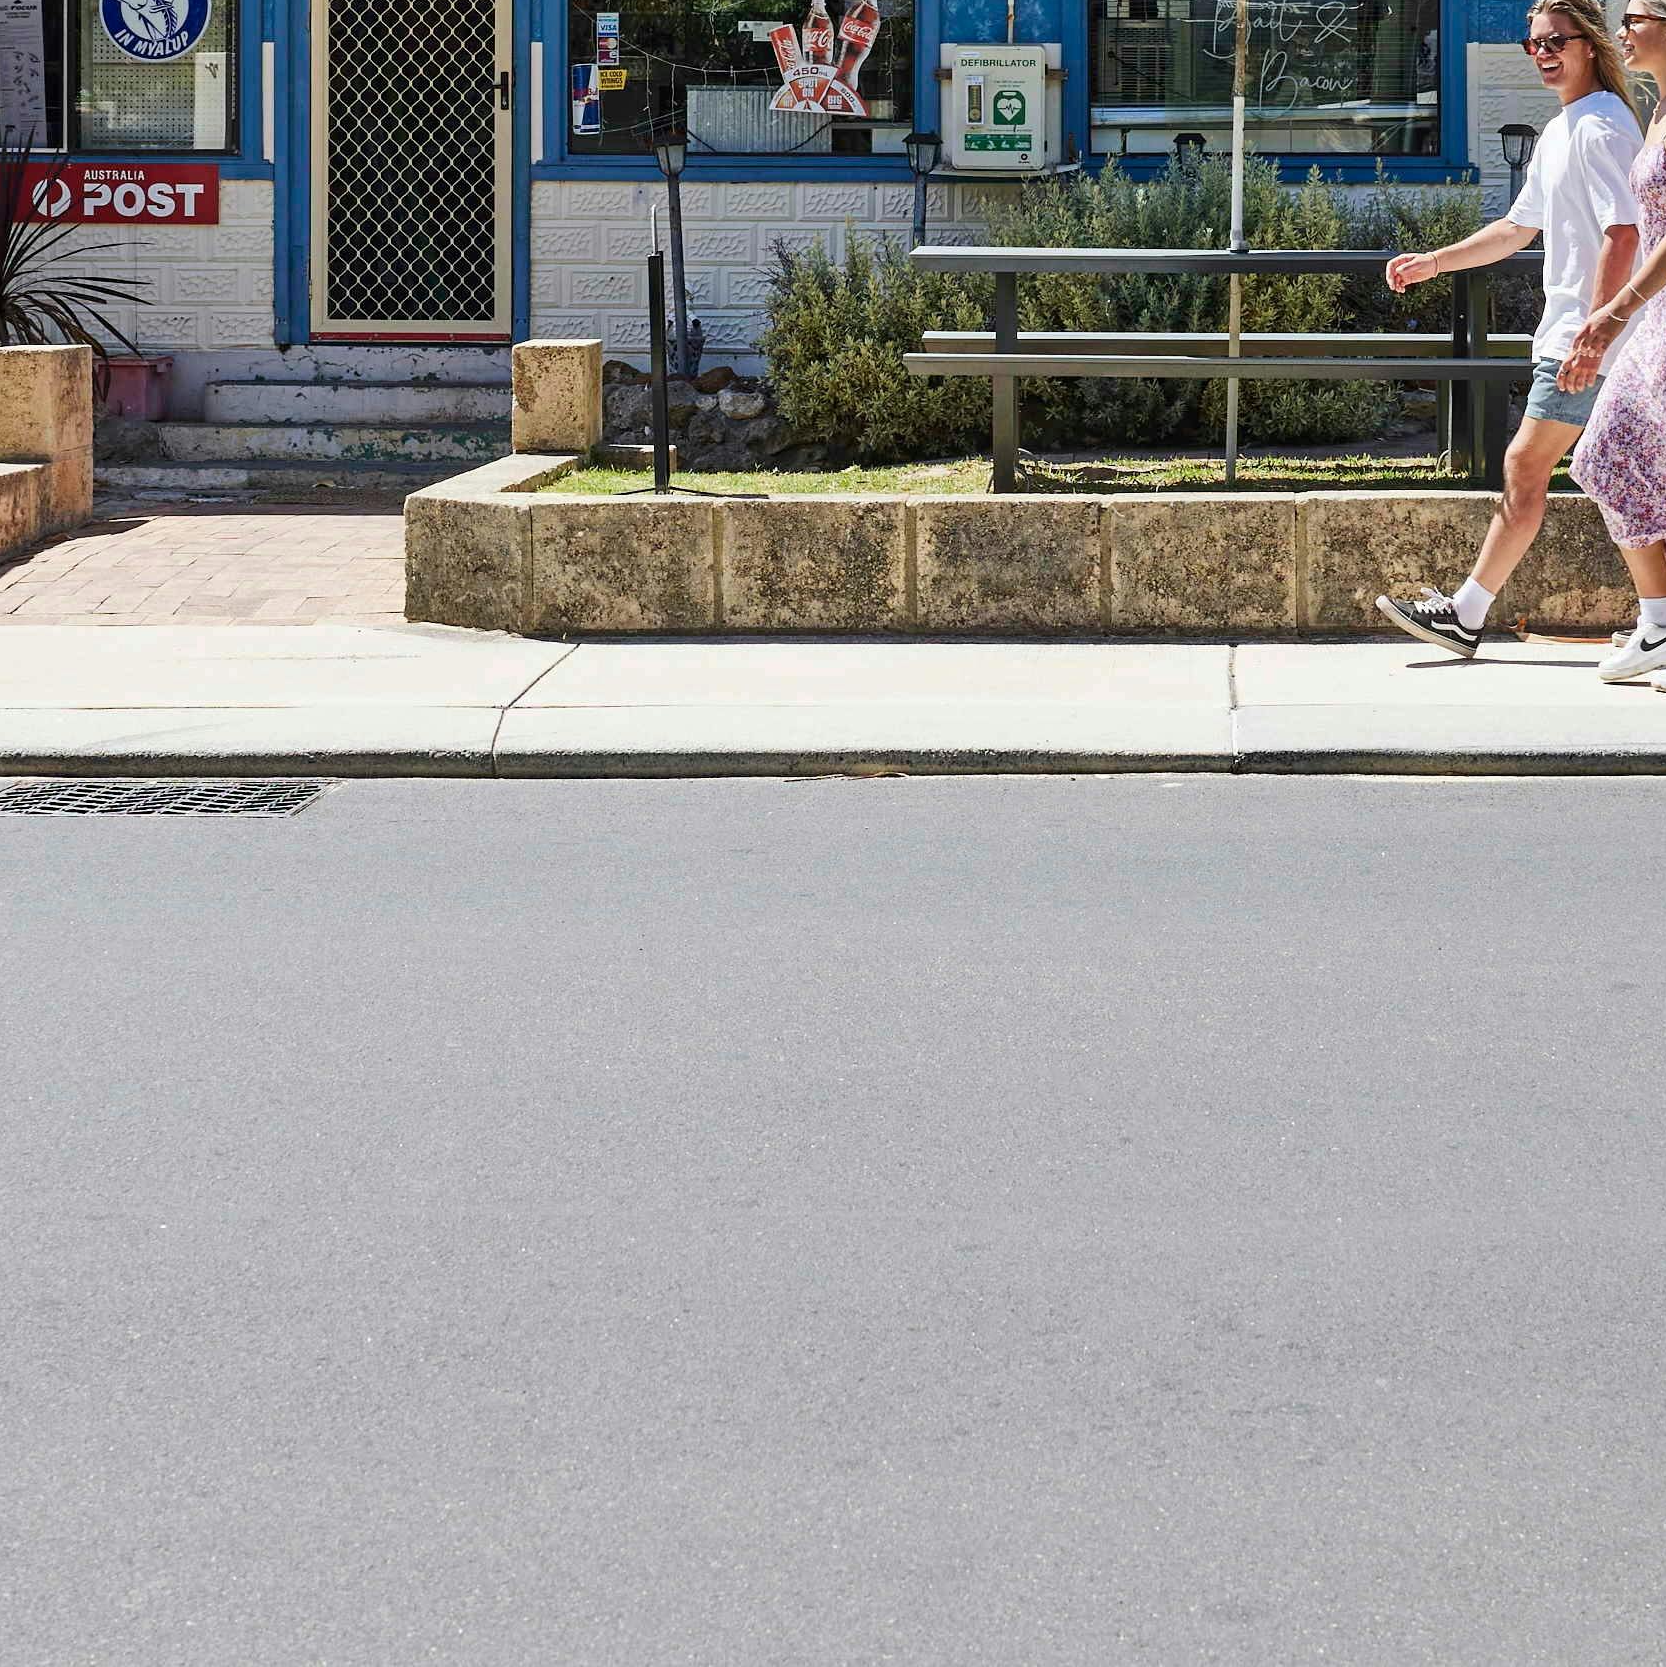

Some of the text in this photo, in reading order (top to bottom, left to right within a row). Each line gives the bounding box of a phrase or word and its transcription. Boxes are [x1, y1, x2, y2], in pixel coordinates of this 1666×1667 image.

[114, 28, 189, 57] IN MYALUP
[960, 59, 1037, 67] DEFIBRILLATOR
[84, 170, 145, 181] AUSTRALIA
[83, 183, 204, 217] POST
